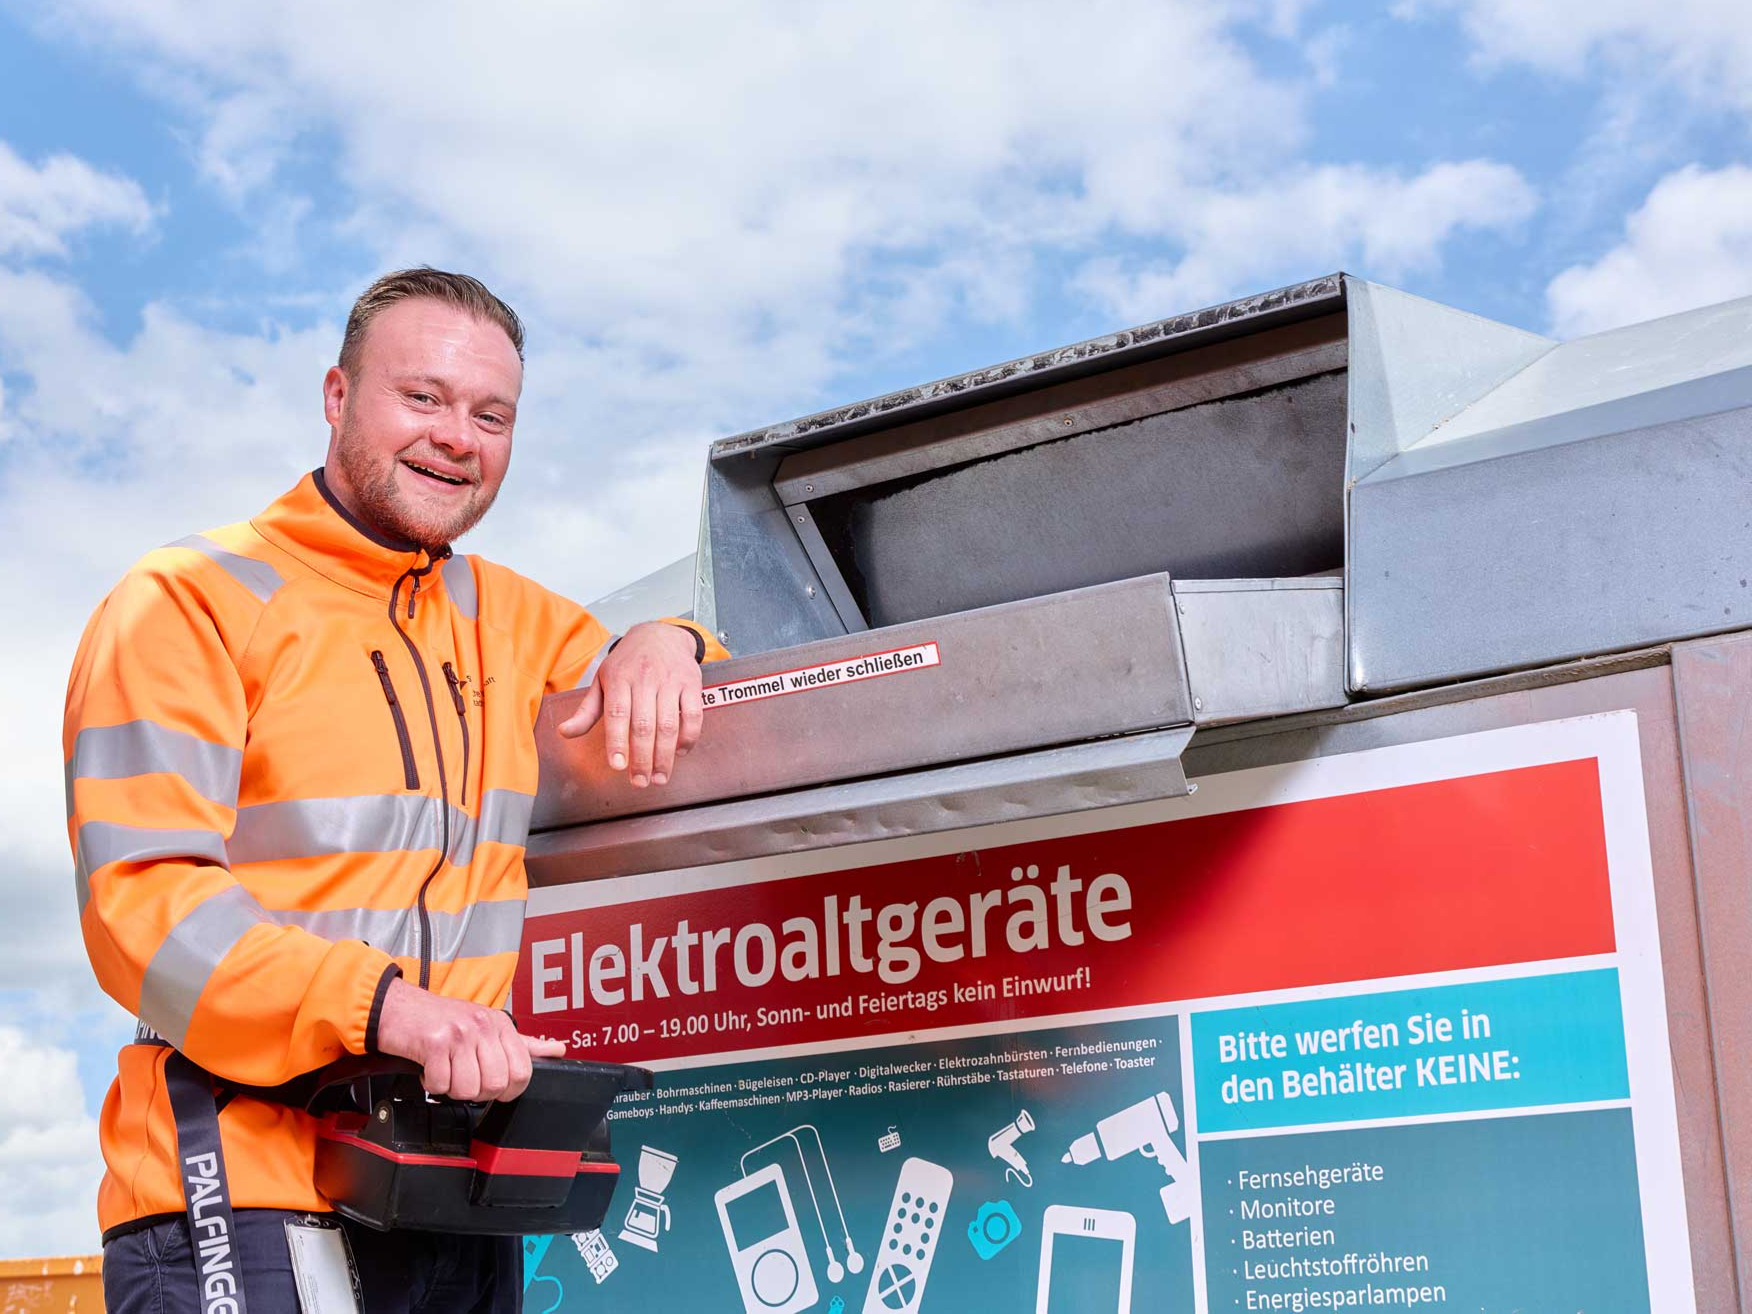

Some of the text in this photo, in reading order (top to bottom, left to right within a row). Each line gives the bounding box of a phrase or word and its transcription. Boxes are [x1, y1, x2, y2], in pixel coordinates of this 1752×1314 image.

[718, 679, 784, 702] Trommel
[790, 667, 842, 689] wieder
[846, 652, 924, 678] schließen
[532, 865, 1132, 1014] Elektroaltgeräte
[572, 1030, 597, 1048] Sa:
[602, 1023, 639, 1045] 7.00
[660, 1014, 708, 1038] 19.00
[714, 1010, 751, 1033] Uhr,
[757, 1007, 810, 1027] Sonn-
[817, 996, 853, 1020] und
[859, 986, 948, 1015] Feiertags
[953, 980, 996, 1003] kein
[1002, 966, 1091, 998] Einwurf!
[1218, 1008, 1491, 1063] Bitte werfen Sie in
[606, 1056, 1156, 1120] Gameboys Handys Kaffeemaschinen MP3-Player Radios Rasierer Rührstäbe Tastaturen Telefone Toaster
[656, 1083, 732, 1099] Bohrmaschinen
[738, 1076, 793, 1092] Bügeleisen
[800, 1069, 851, 1084] CD-Player
[859, 1061, 931, 1079] Digitalwecker
[939, 1050, 1048, 1070] Elektrozahnbürsten
[1055, 1038, 1157, 1058] Fernbedienungen
[1221, 1050, 1521, 1104] den Behälter KEINE:
[1239, 1162, 1384, 1190] Fernsehgeräte
[1240, 1197, 1335, 1220] Monitore
[1242, 1227, 1335, 1250] Batterien
[1244, 1252, 1429, 1280] Leuchtstoffröhren
[1246, 1283, 1446, 1312] Energiesparlampen
